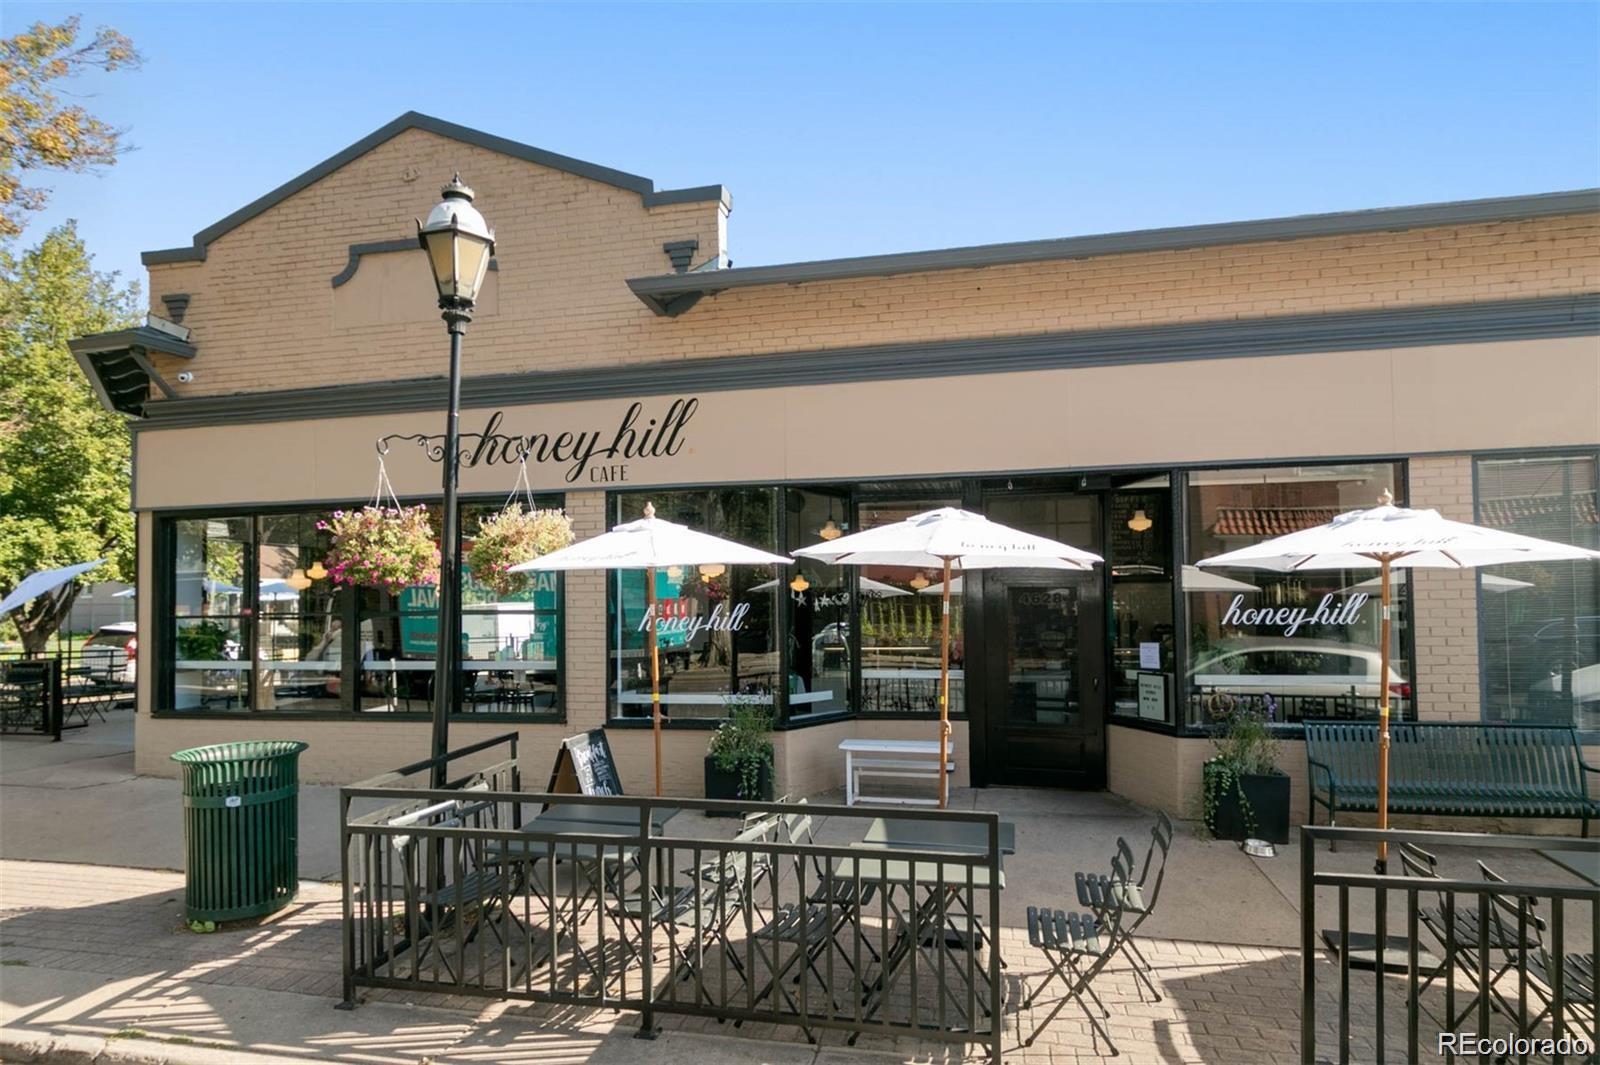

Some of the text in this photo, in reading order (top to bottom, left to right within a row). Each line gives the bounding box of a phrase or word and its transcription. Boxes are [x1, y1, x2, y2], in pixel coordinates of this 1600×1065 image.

[472, 398, 699, 483] honey hill
[590, 464, 629, 482] CAFE
[638, 603, 704, 642] honey
[704, 602, 750, 631] hill
[1221, 593, 1369, 638] honey hill
